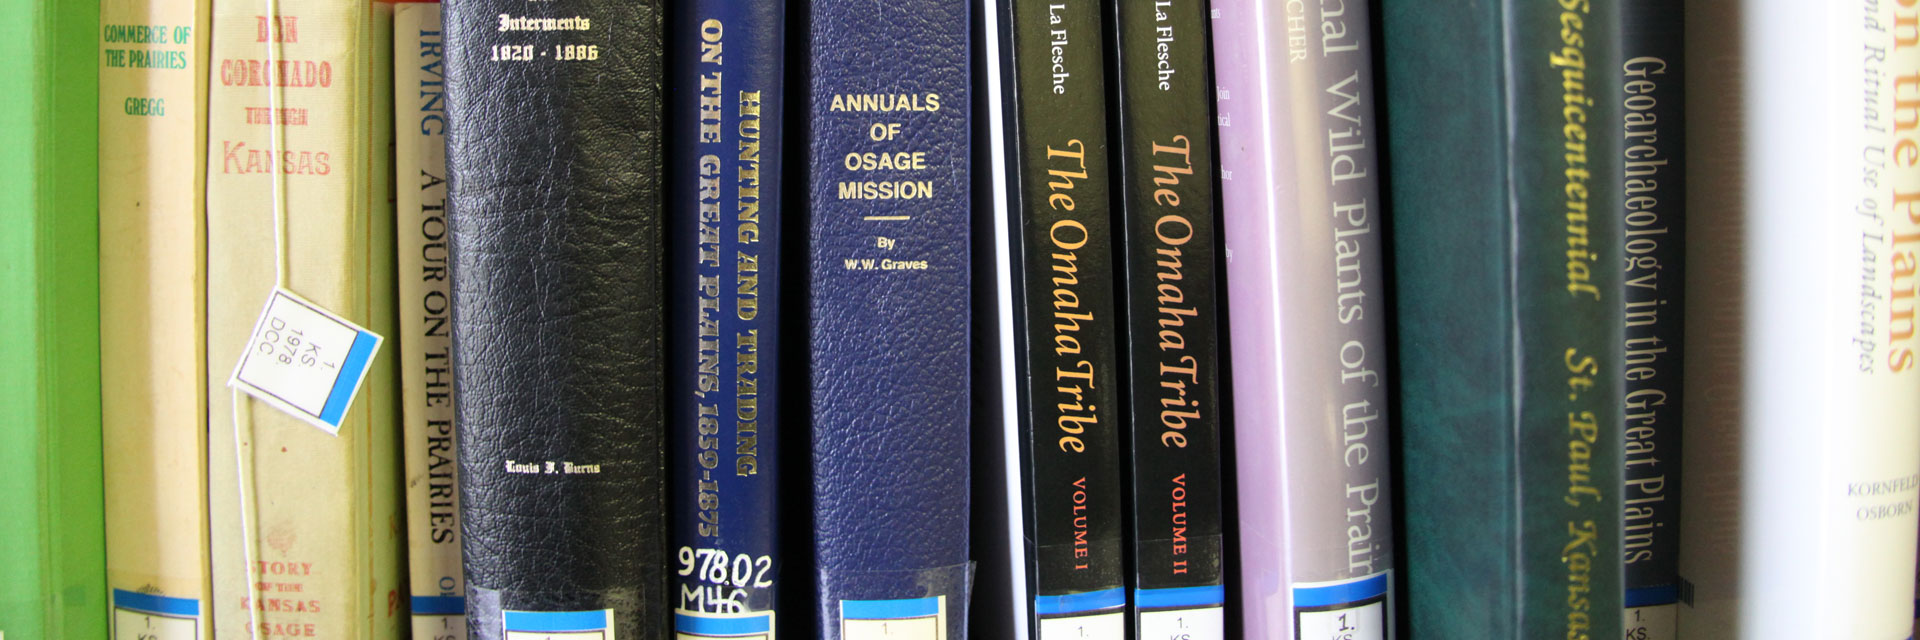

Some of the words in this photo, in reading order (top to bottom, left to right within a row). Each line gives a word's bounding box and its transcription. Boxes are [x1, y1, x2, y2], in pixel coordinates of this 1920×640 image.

[104, 24, 167, 44] COMMERCE
[173, 25, 191, 44] OF
[498, 13, 591, 31] Interments
[700, 18, 723, 66] ON
[1049, 4, 1066, 25] La
[1155, 1, 1171, 22] La
[105, 49, 126, 68] THE
[128, 49, 187, 69] PRAIRIES
[420, 29, 445, 136] IRVING
[490, 44, 534, 61] 1820
[555, 44, 599, 61] 1886
[1051, 29, 1070, 95] Flesche
[1156, 26, 1175, 91] Flesche
[124, 97, 165, 116] GREGG
[700, 71, 722, 144] THE
[829, 93, 941, 112] ANNUALS
[1863, 43, 1887, 133] Ritual
[869, 122, 902, 142] OF
[1325, 69, 1366, 186] Wild
[421, 169, 446, 191] A
[737, 89, 761, 245] HUNTING
[838, 180, 933, 200] MISSION
[844, 151, 926, 171] OSAGE
[1047, 138, 1088, 212] The
[1152, 134, 1194, 207] The
[1623, 55, 1668, 290] Geoarchaeology
[1863, 145, 1887, 189] Use
[421, 199, 447, 283] TOUR
[699, 154, 721, 268] GREAT
[877, 236, 896, 250] By
[1855, 197, 1884, 227] of
[737, 251, 760, 321] AND
[881, 258, 929, 270] Graves
[1050, 219, 1095, 356] Omaha
[1154, 214, 1199, 351] Omaha
[1333, 198, 1371, 325] Plants
[1887, 187, 1920, 375] Plains
[423, 290, 449, 338] ON
[1624, 299, 1667, 328] in
[1853, 231, 1884, 375] Landscapes
[694, 274, 720, 399] PLAINS,
[1340, 340, 1379, 388] of
[1624, 335, 1667, 381] the
[425, 347, 450, 408] THE
[736, 329, 758, 478] TRADING
[1056, 359, 1098, 453] Tribe
[1160, 355, 1201, 448] Tribe
[1564, 347, 1598, 401] St.
[1342, 399, 1379, 467] the
[1564, 411, 1603, 507] Paul,
[1624, 388, 1667, 470] Great
[427, 419, 455, 545] PRAIRIES
[698, 403, 719, 538] 1859-1875
[1072, 476, 1089, 559] VOLUME
[1171, 473, 1188, 555] VOLUME
[1624, 474, 1665, 564] Plains
[1856, 500, 1914, 521] OSBORN
[677, 546, 773, 588] 978.02
[680, 583, 749, 614] M46
[1173, 560, 1188, 575] II
[1338, 612, 1356, 632] 1.
